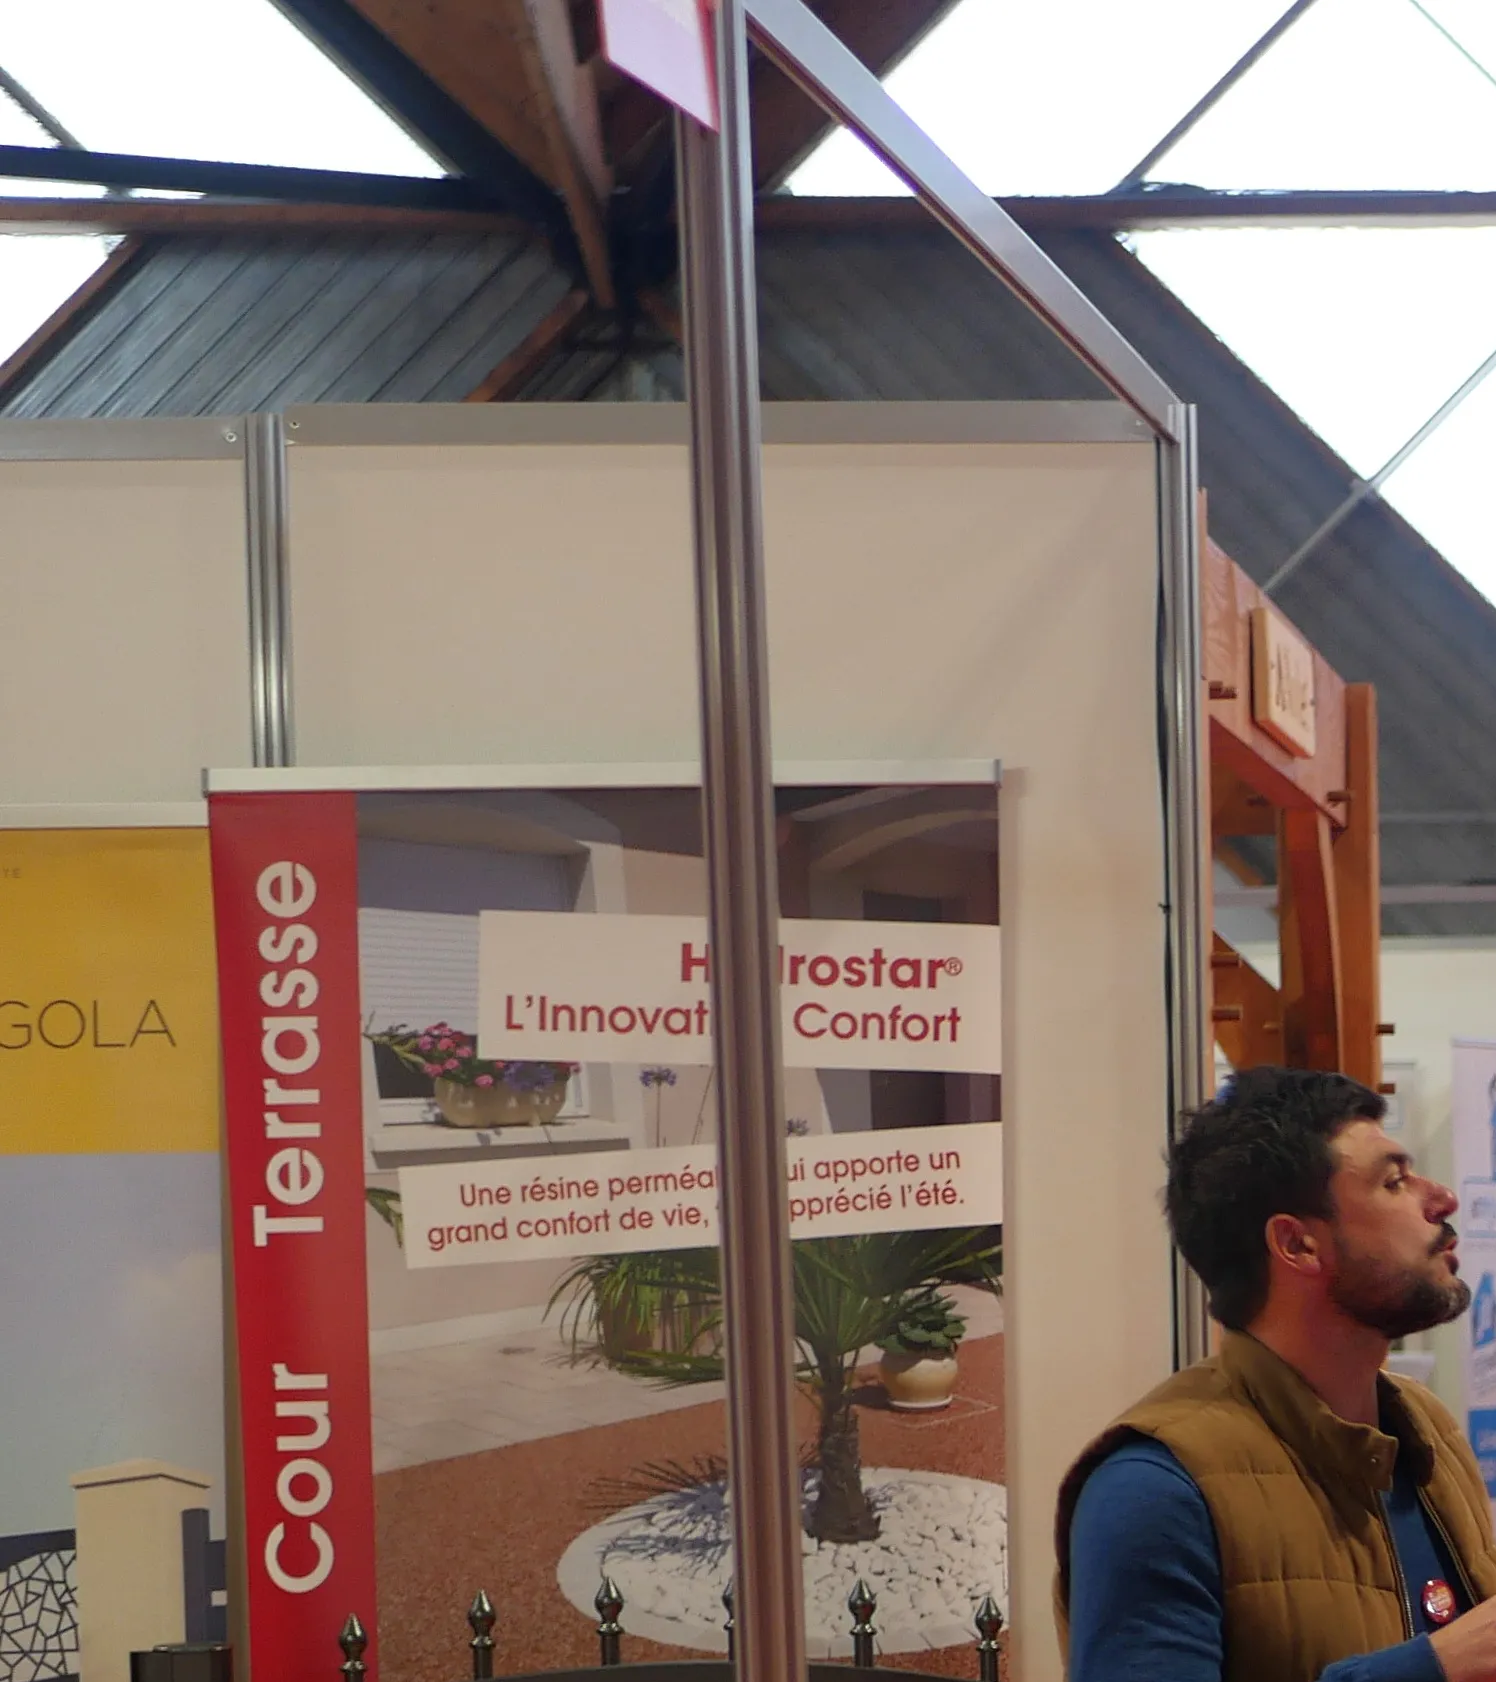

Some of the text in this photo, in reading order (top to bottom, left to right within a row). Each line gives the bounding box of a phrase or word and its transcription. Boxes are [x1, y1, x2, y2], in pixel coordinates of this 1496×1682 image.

[253, 861, 325, 1247] Terrasse
[793, 1002, 962, 1042] Confort
[460, 1149, 960, 1207] Une résine perméa ui apporte un
[427, 1179, 965, 1252] grand confort de vie, pprécié l’été.
[264, 1363, 335, 1593] Cour
